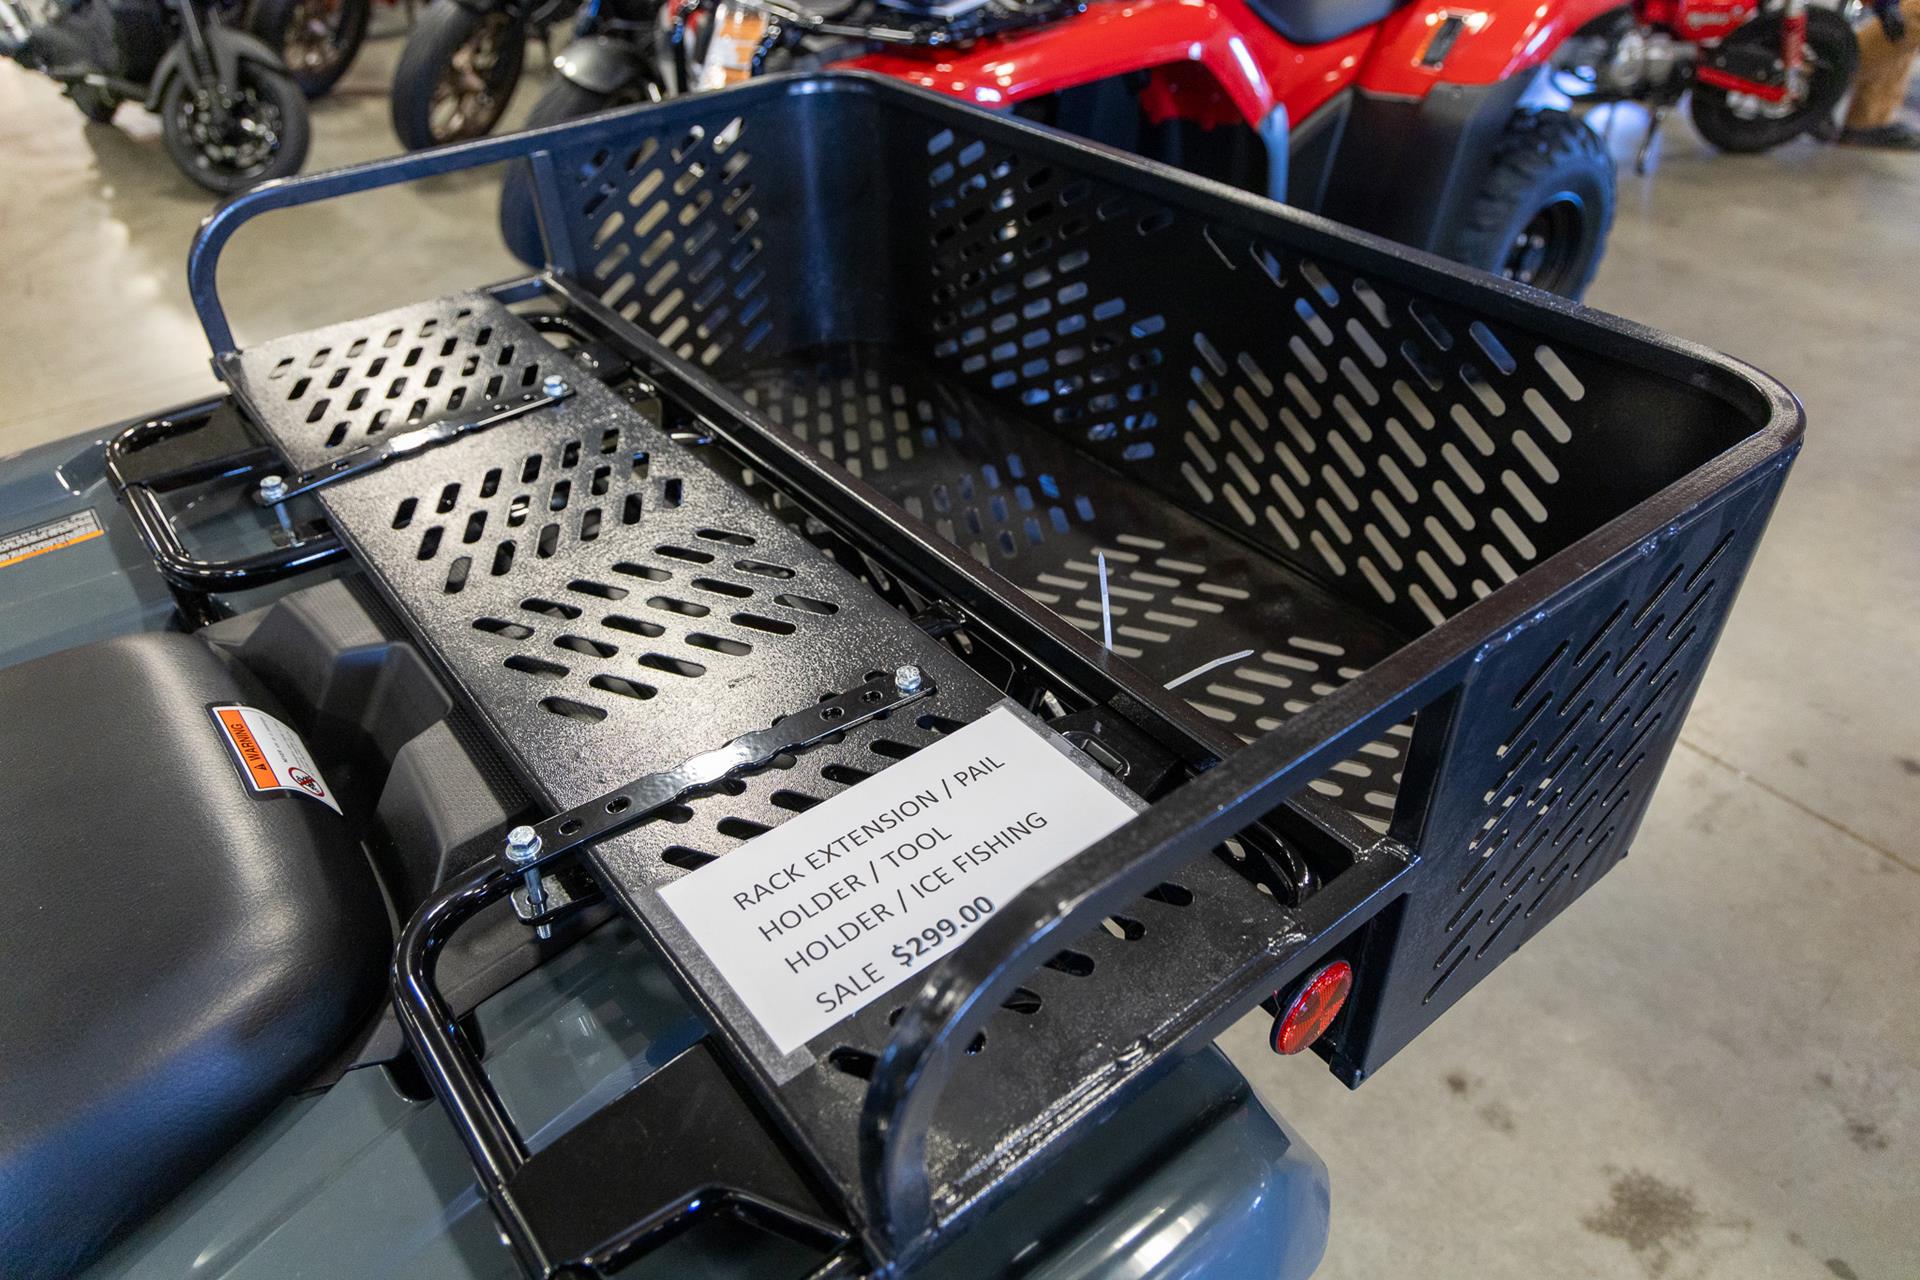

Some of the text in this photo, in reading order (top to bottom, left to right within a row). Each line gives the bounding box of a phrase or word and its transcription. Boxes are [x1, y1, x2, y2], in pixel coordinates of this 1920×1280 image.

[231, 723, 261, 761] WARNING
[732, 756, 1005, 911] RACK EXTENSION / PAIL
[758, 827, 953, 942] HOLDER / TOOL
[784, 811, 1048, 974] HOLDER / ICE FISHING
[816, 896, 995, 1013] SALE $299.00
